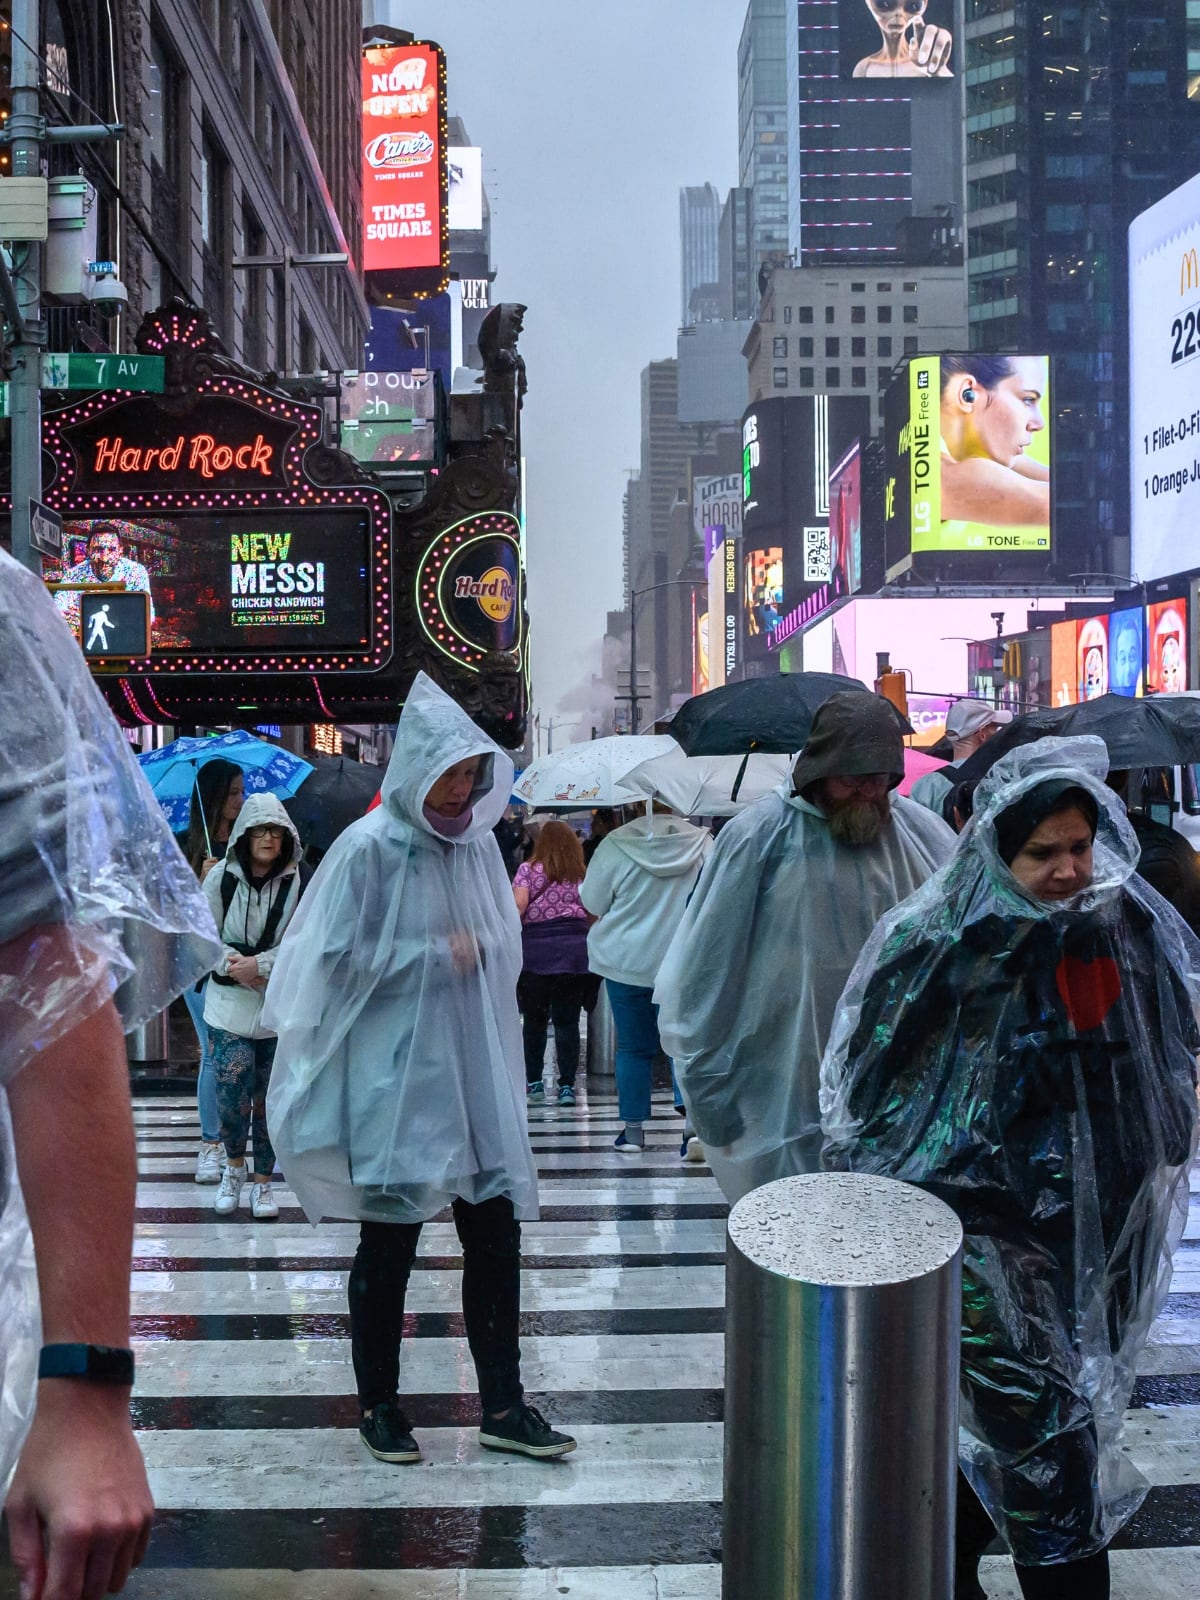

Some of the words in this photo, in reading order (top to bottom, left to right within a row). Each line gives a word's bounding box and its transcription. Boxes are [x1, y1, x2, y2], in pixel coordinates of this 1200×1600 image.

[371, 72, 424, 93] NOW
[369, 93, 429, 117] OPEN
[369, 132, 433, 166] Cane's
[371, 202, 426, 221] TIMES
[366, 220, 432, 241] SQUARE
[88, 262, 113, 273] NYPD
[463, 298, 488, 309] OUR
[1171, 308, 1200, 364] 22
[95, 359, 107, 384] 7
[118, 360, 139, 376] Av
[918, 371, 928, 387] fit
[919, 392, 930, 420] Free
[1144, 434, 1149, 455] 1
[95, 436, 185, 472] Hard
[189, 434, 272, 478] Rock
[914, 424, 930, 494] TONE
[702, 476, 739, 499] LITTLE
[1144, 478, 1149, 499] 1
[1152, 467, 1188, 497] Orange
[914, 501, 931, 533] LG
[231, 532, 292, 562] NEW
[987, 536, 1021, 546] TONE
[726, 546, 735, 560] BIG
[231, 562, 325, 594] MESSI
[455, 576, 500, 598] Hard
[726, 561, 735, 592] SCREEN
[232, 597, 272, 608] CHICKEN
[274, 595, 324, 608] SANDWICH
[490, 603, 507, 611] CAFE
[726, 615, 735, 627] GO
[726, 629, 735, 640] TO
